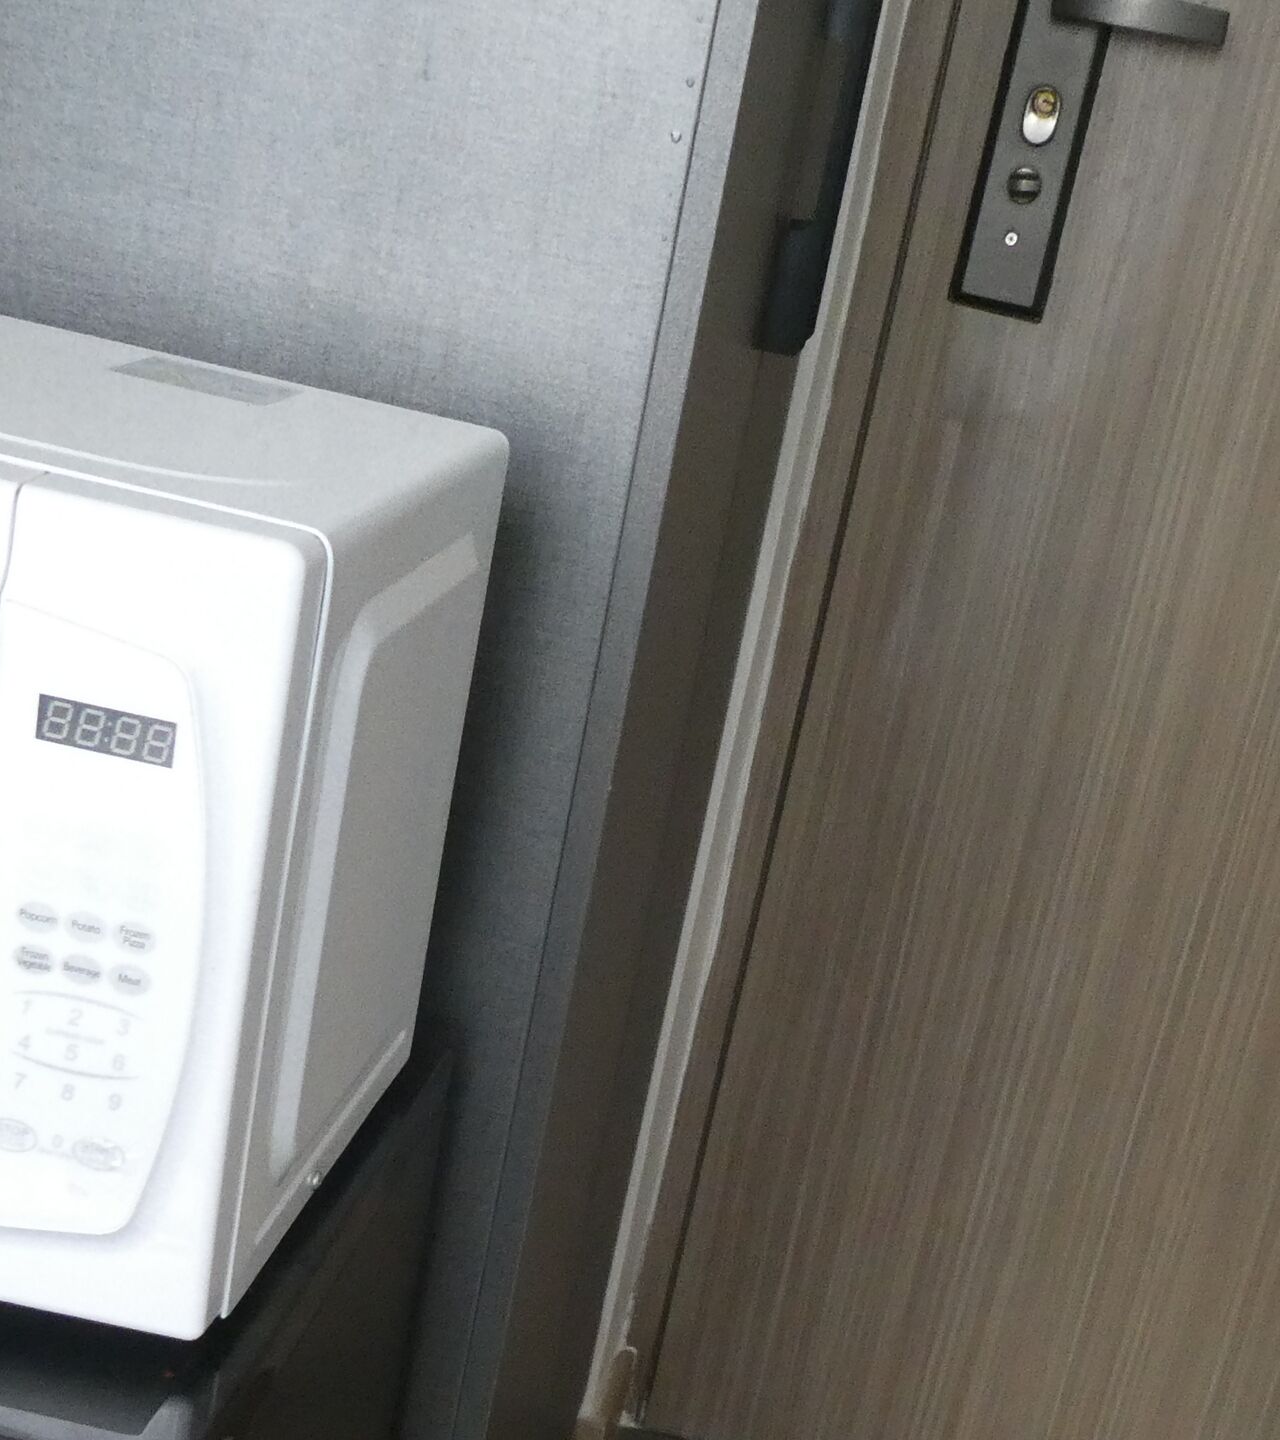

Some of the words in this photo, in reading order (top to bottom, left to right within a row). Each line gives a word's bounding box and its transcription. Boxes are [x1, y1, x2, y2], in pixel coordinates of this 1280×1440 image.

[67, 1008, 83, 1026] 2
[64, 1044, 78, 1061] 5
[112, 1053, 125, 1071] 6
[15, 1072, 27, 1088] 7
[62, 1083, 75, 1101] 8
[108, 1093, 122, 1111] 9
